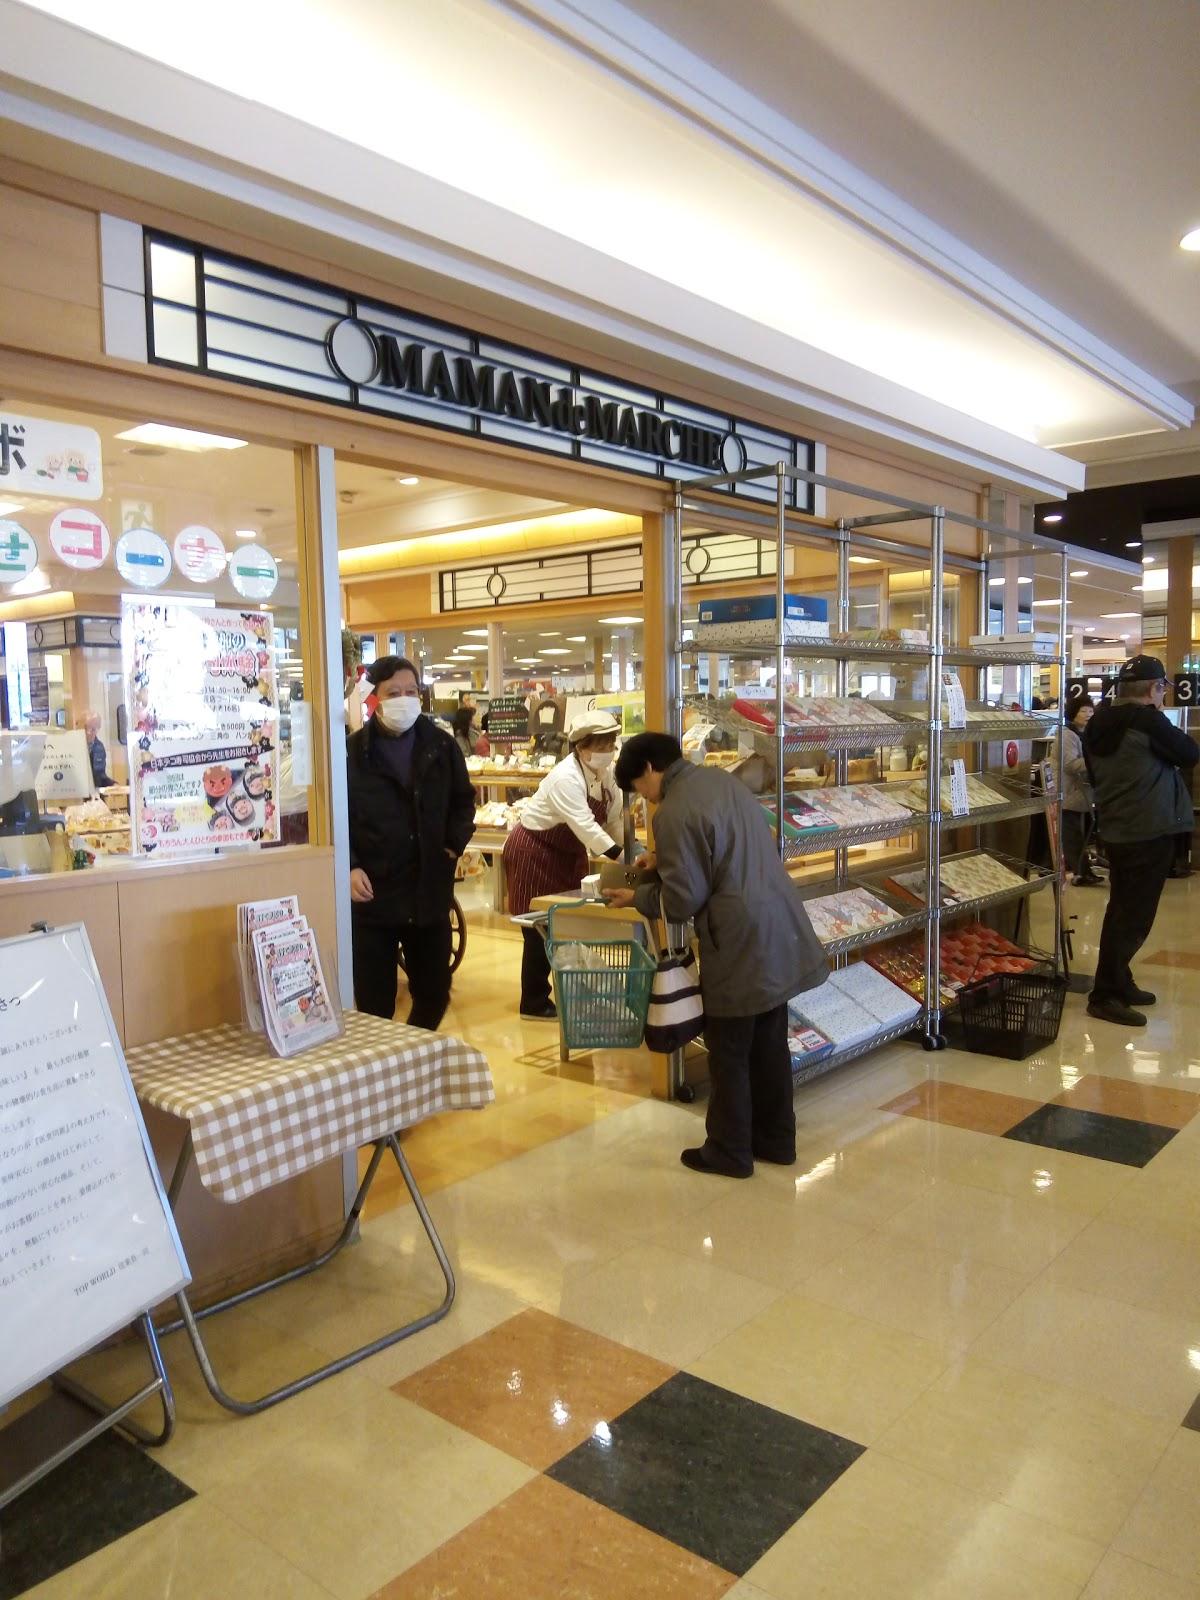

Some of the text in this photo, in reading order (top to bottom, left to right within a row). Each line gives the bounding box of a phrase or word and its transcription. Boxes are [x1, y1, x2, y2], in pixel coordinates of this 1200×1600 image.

[378, 334, 552, 427] MAMAN
[1104, 684, 1117, 700] 4
[1177, 680, 1192, 700] 3
